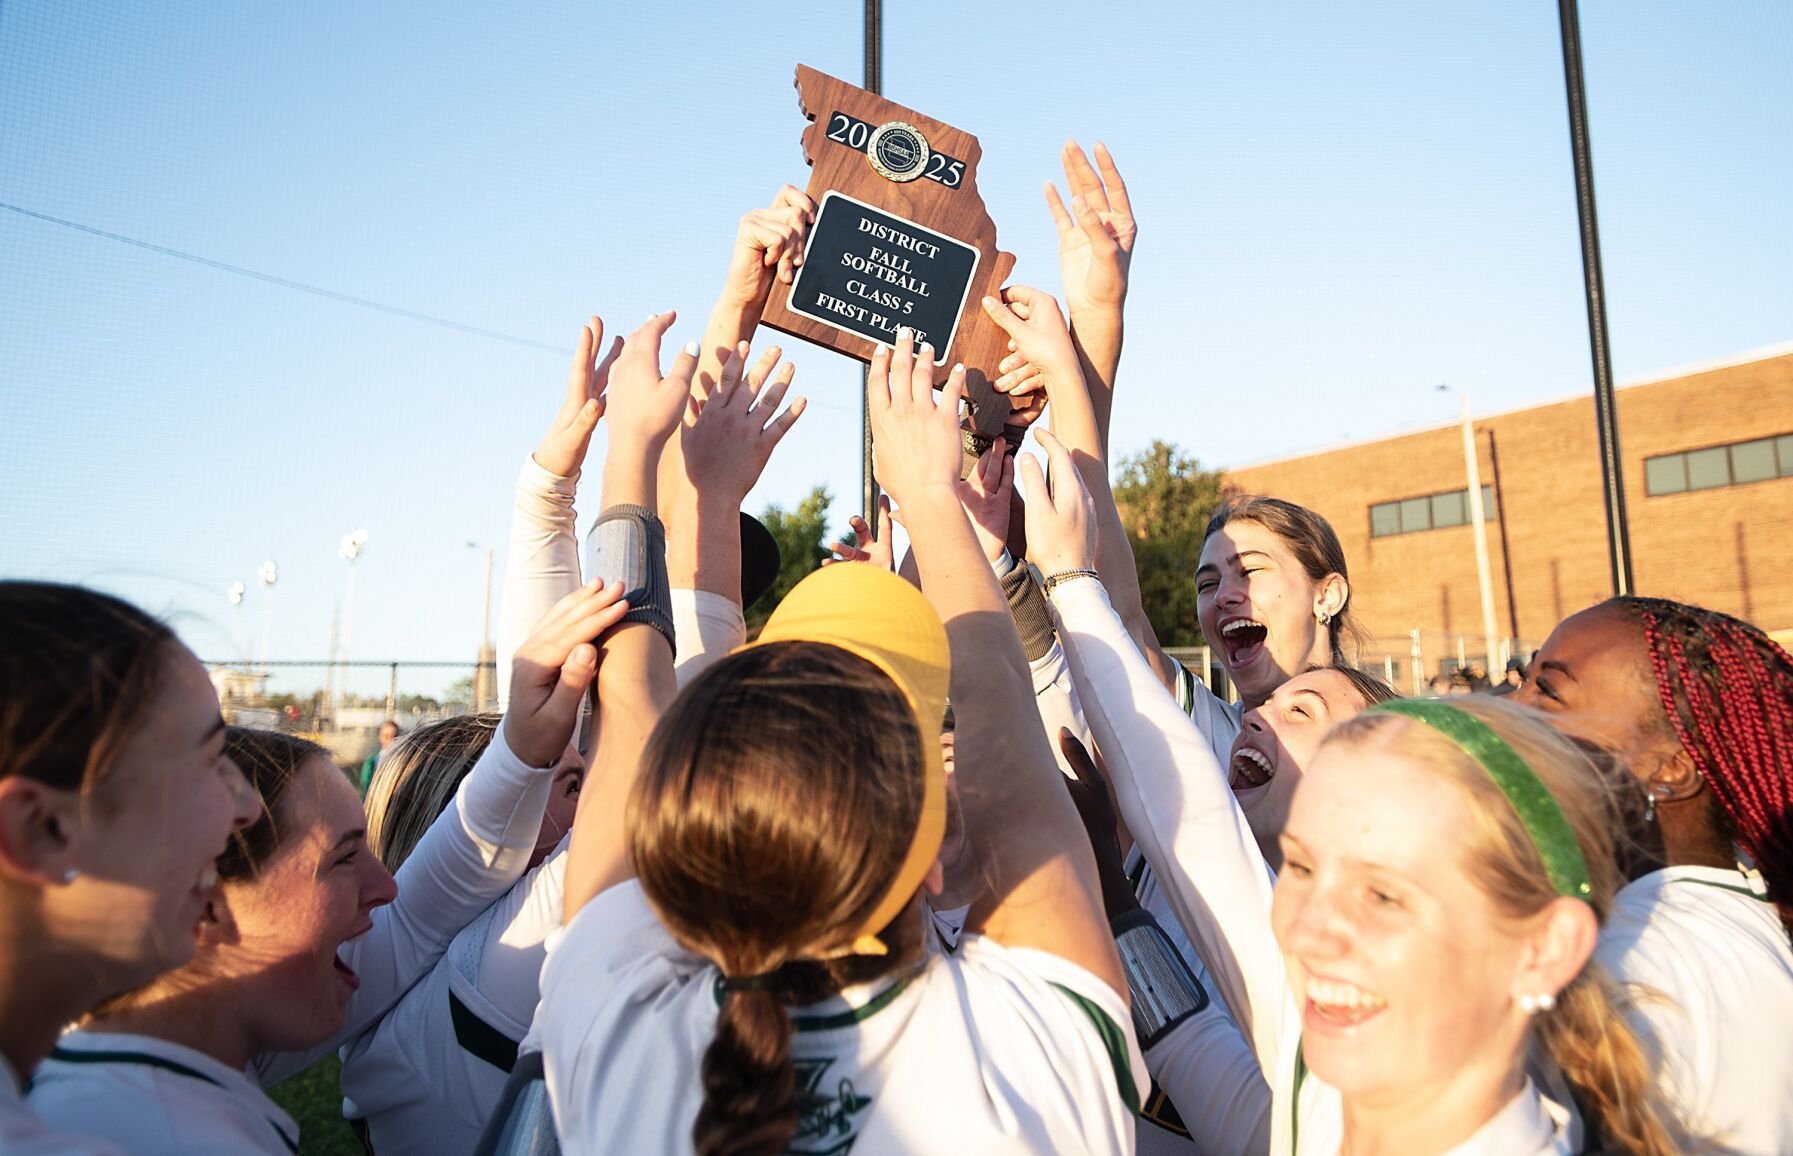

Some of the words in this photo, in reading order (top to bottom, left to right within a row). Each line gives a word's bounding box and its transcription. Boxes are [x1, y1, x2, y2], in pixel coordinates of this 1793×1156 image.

[827, 114, 868, 148] 20
[925, 154, 965, 186] 25
[857, 217, 940, 260] DISTRICT
[868, 246, 913, 275] FALL
[840, 252, 930, 298] SOFTBALL
[846, 279, 902, 310] CLASS
[902, 301, 915, 315] 5
[815, 292, 869, 322] FIRST
[868, 312, 927, 344] PLAE
